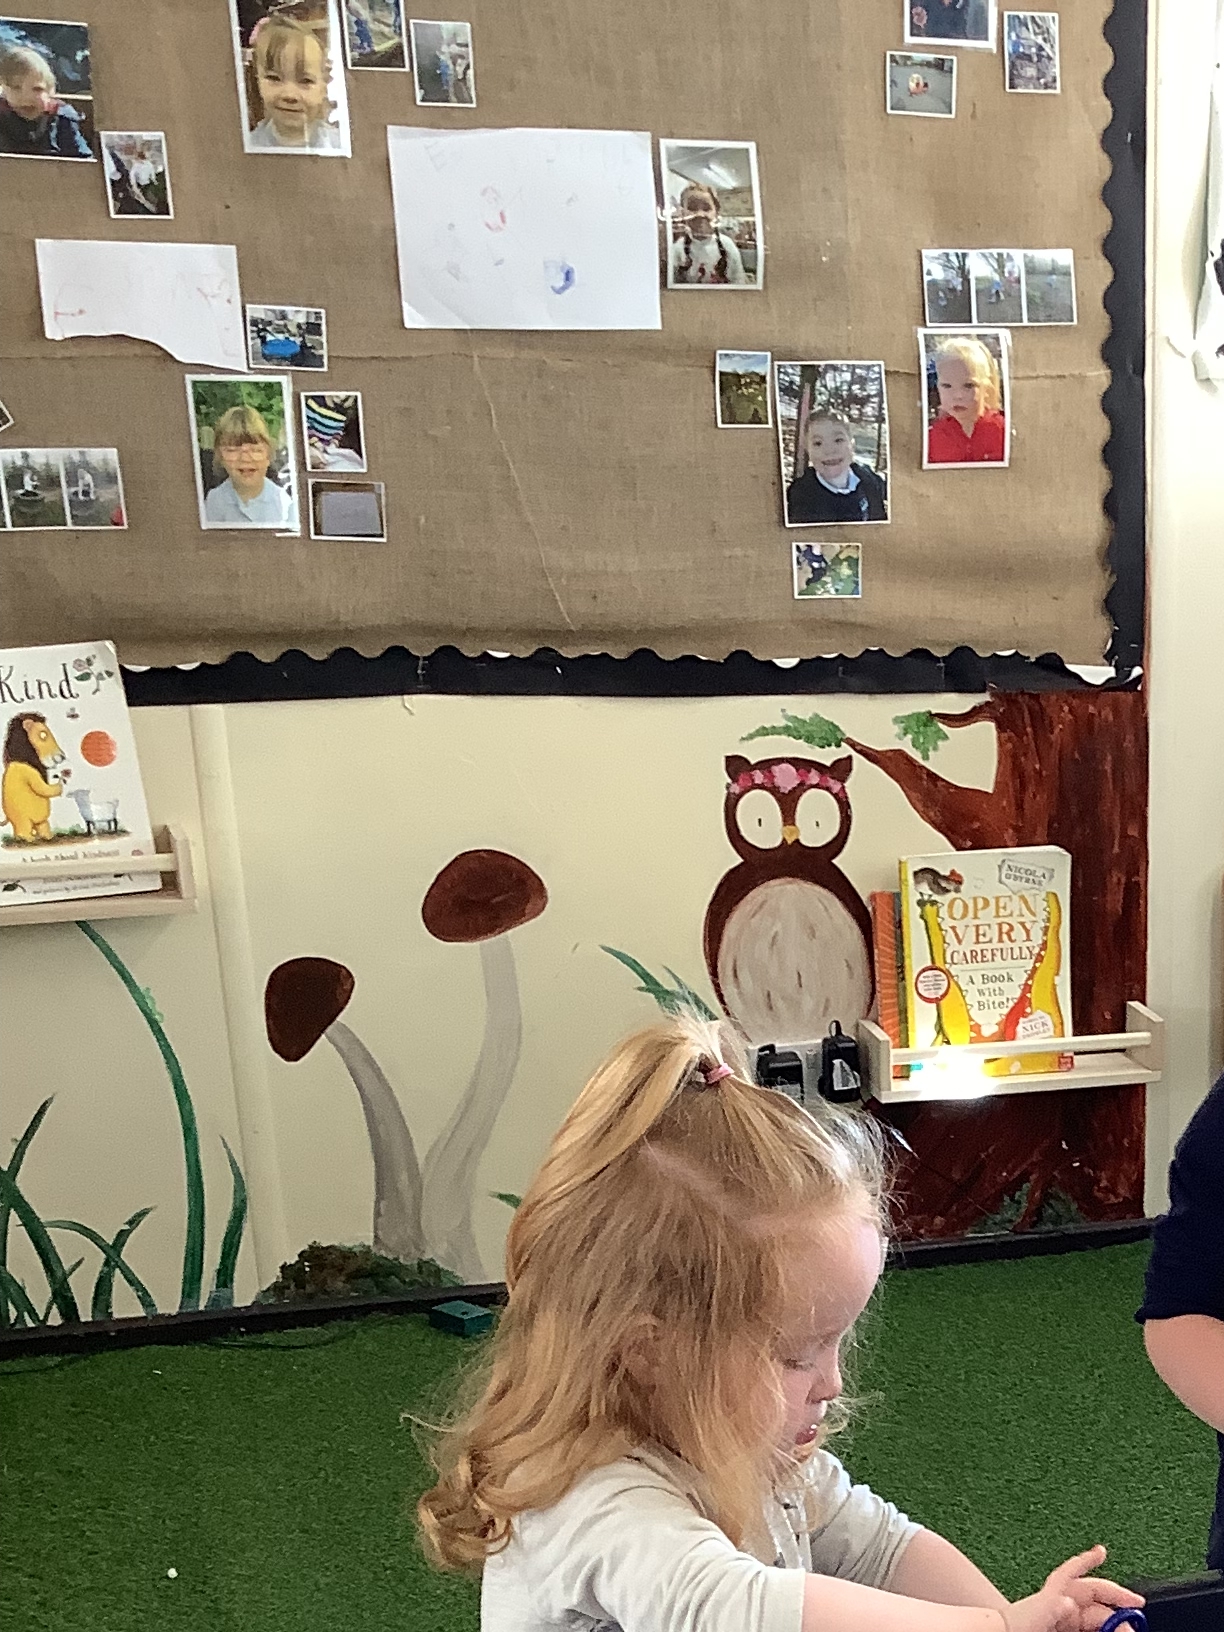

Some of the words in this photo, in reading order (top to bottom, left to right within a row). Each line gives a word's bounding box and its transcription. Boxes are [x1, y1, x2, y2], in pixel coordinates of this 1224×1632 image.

[0, 663, 79, 704] Kind
[1005, 864, 1047, 880] NICOLA
[946, 893, 1040, 921] OPEN
[948, 920, 1039, 946] VERY
[950, 946, 1036, 966] CAREFULLY
[966, 974, 976, 986] A
[981, 971, 1015, 985] Book
[977, 997, 1010, 1012] Bite!
[1021, 1019, 1049, 1032] NICK
